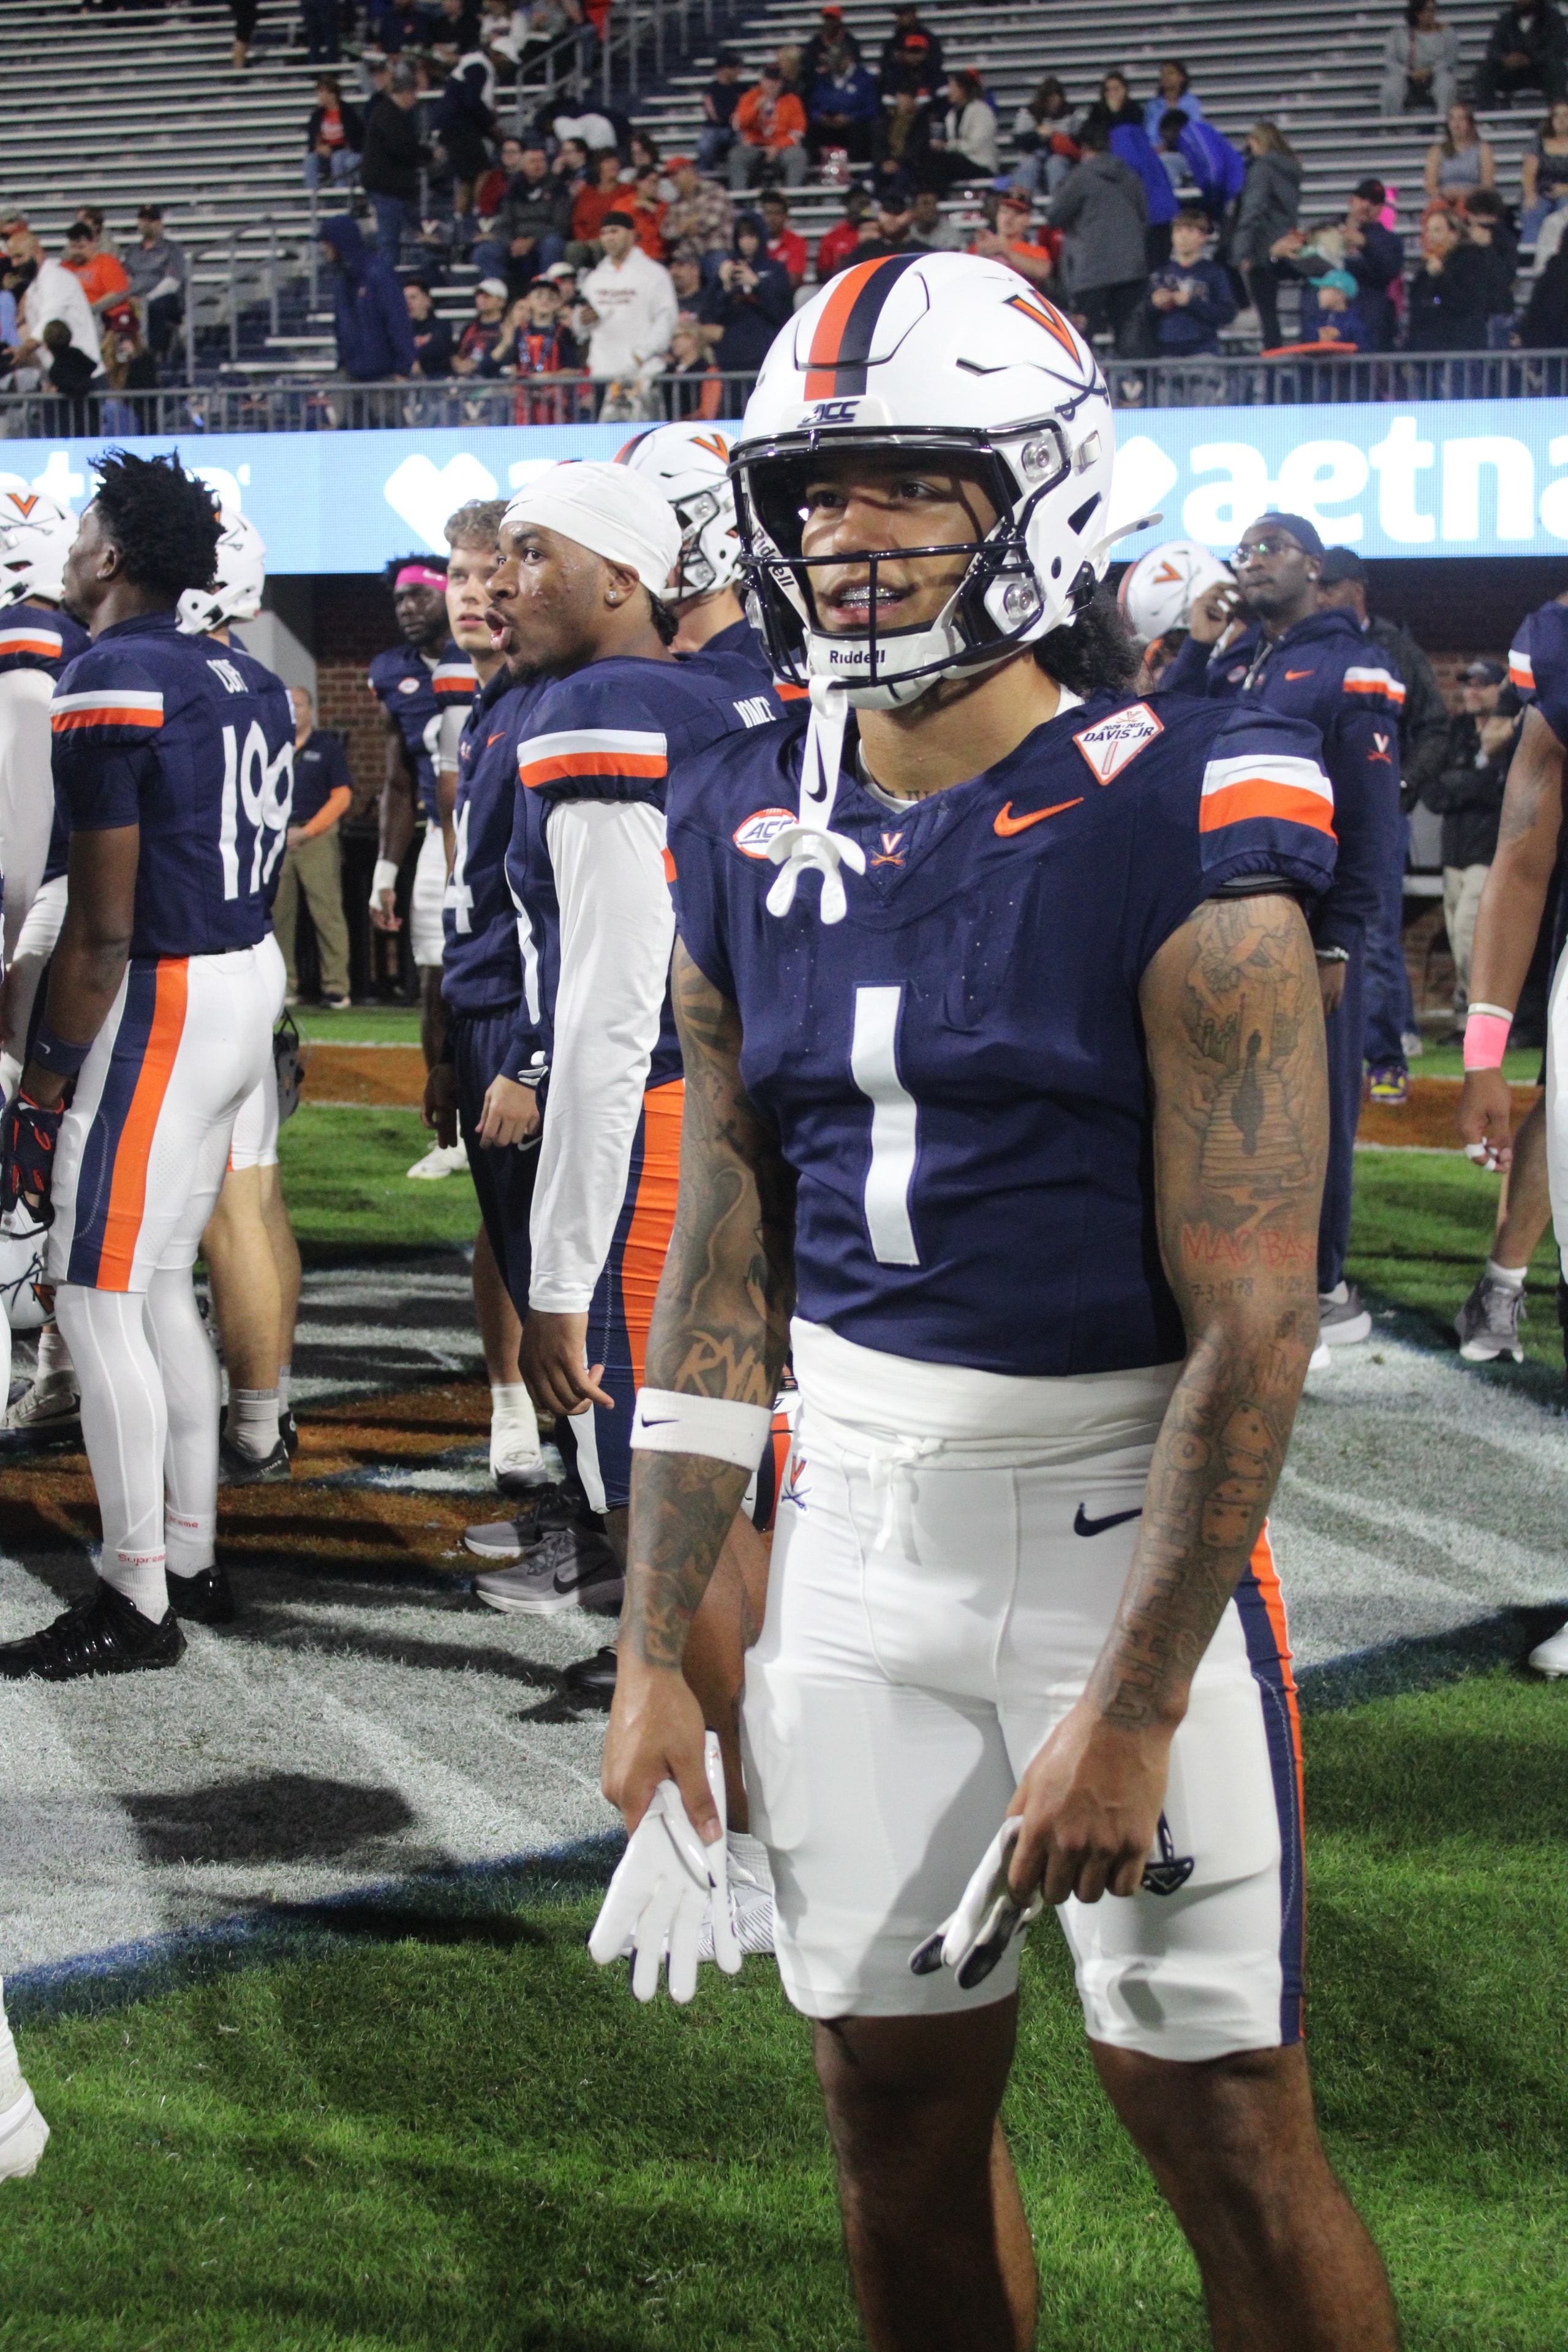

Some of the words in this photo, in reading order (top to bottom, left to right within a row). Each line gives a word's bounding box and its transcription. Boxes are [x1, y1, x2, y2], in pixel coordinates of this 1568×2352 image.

[800, 401, 861, 424] ACC
[752, 527, 795, 587] Ridell
[830, 649, 886, 664] Riddell
[1083, 729, 1131, 742] DAVIS
[1131, 726, 1155, 737] JR
[851, 986, 920, 1265] 1
